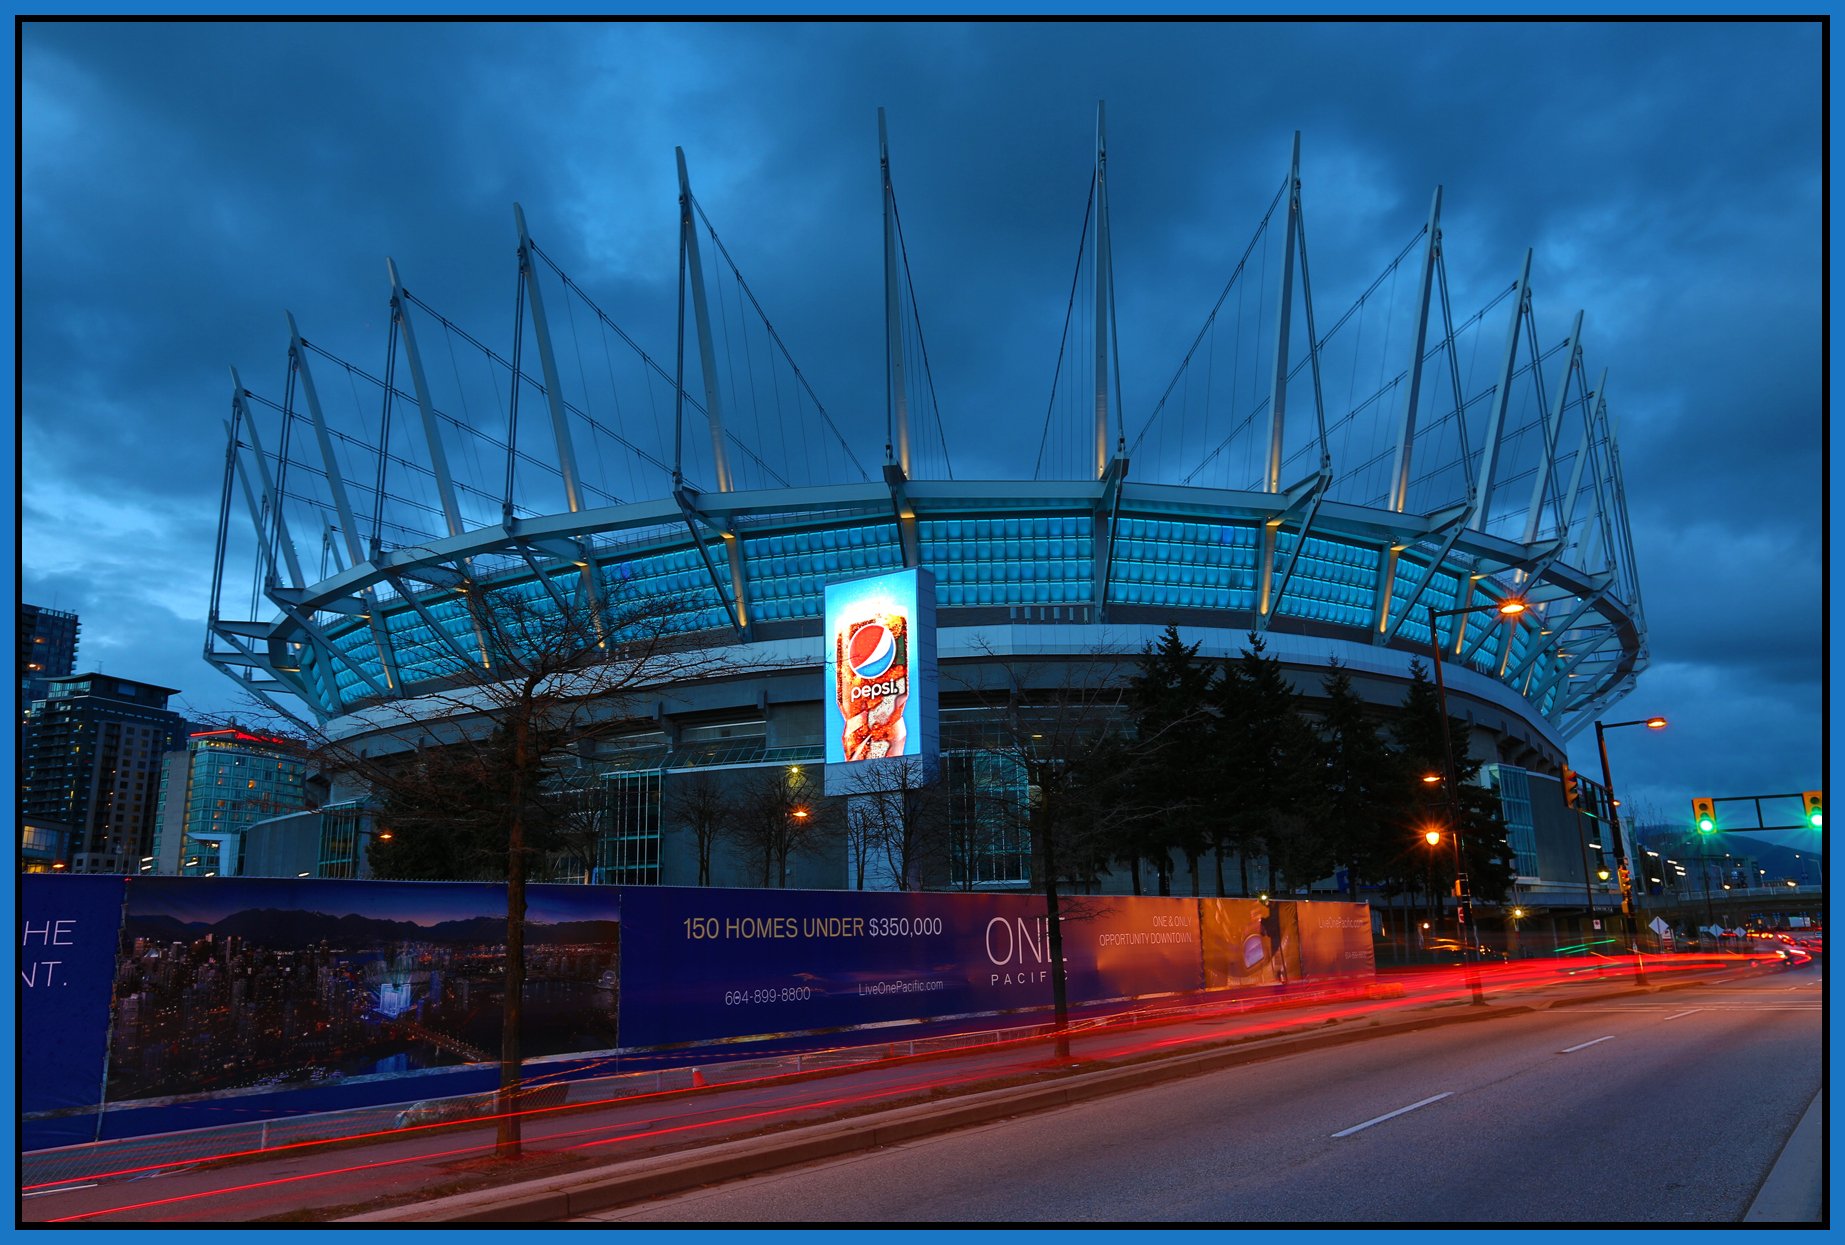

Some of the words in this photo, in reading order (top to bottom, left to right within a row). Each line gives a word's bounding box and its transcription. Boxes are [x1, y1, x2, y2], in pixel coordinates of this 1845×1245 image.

[683, 917, 719, 940] 150
[725, 917, 798, 939] HOMES
[803, 917, 865, 938] UNDER
[868, 917, 943, 937] $350,000
[1152, 915, 1168, 927] ONE
[1174, 915, 1192, 927] ONLY
[1099, 932, 1150, 947] OPPORTUNITY
[991, 970, 1068, 986] PACIF
[858, 979, 944, 996] LiveOnePacific.com
[725, 986, 811, 1006] 604-899-8800
